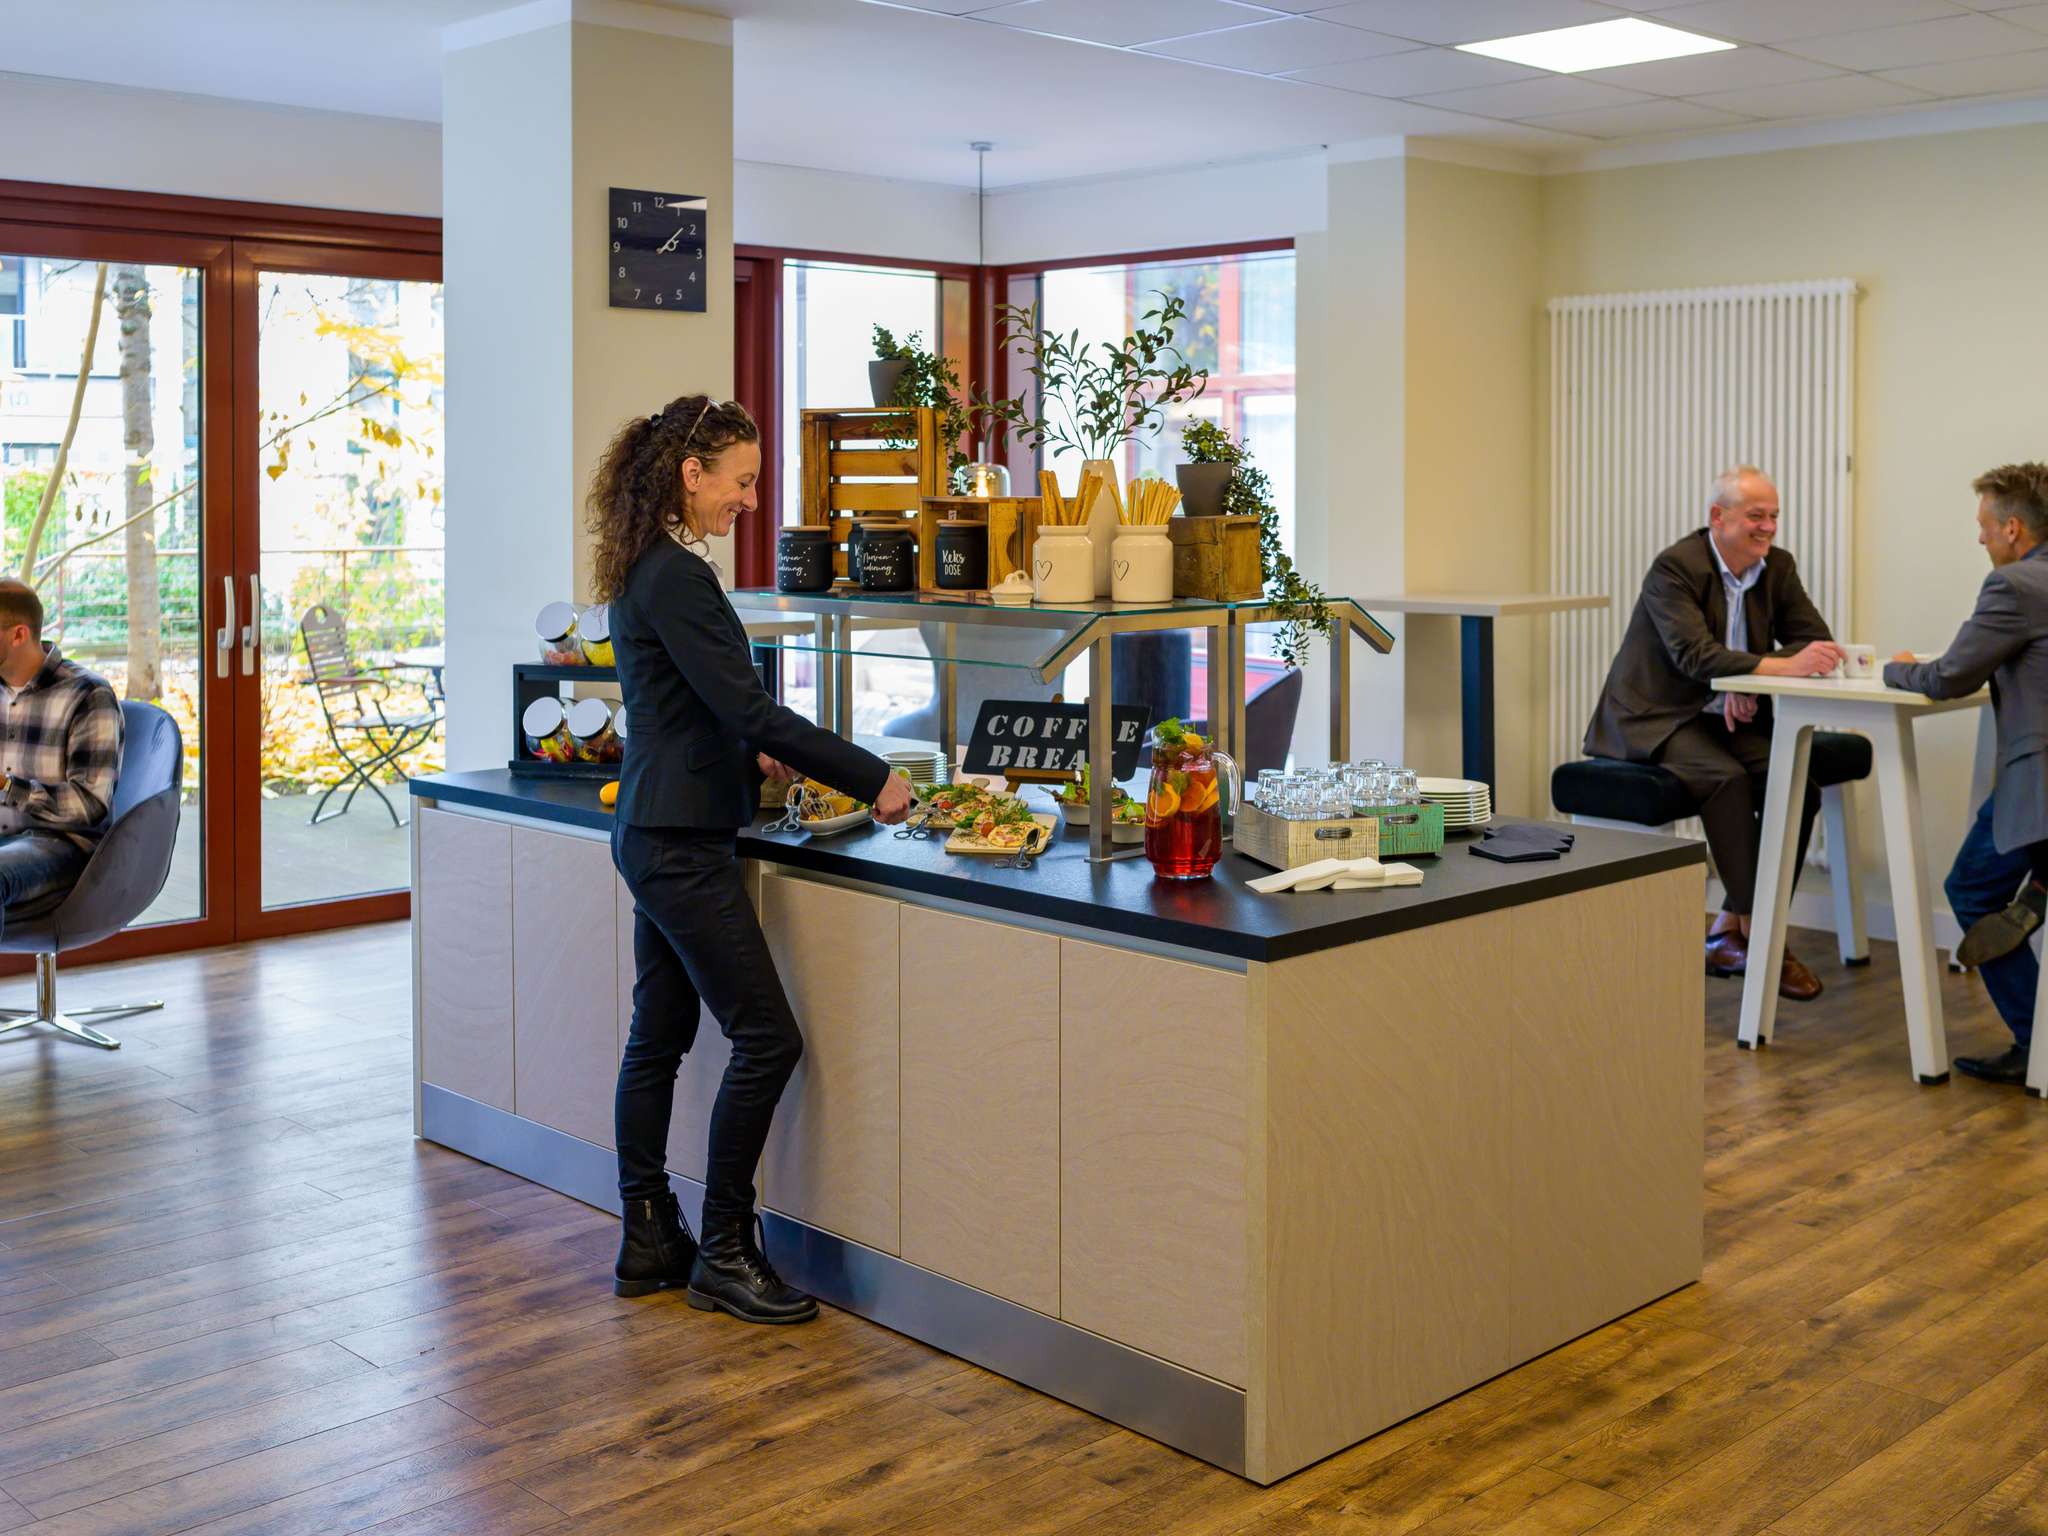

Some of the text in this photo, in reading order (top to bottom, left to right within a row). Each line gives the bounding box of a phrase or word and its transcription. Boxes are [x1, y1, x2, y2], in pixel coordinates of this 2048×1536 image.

[632, 201, 642, 213] 11
[654, 197, 665, 208] 12
[617, 217, 628, 229] 10
[689, 224, 697, 235] 2
[613, 241, 620, 253] 9
[696, 248, 703, 260] 3
[618, 266, 626, 278] 8
[689, 272, 696, 282] 4
[634, 289, 641, 300] 7
[655, 293, 662, 304] 6
[675, 289, 682, 300] 5
[942, 549, 966, 564] Keks
[944, 564, 961, 576] DOSE
[986, 714, 1139, 743] COFFE
[987, 745, 1117, 771] BREA
